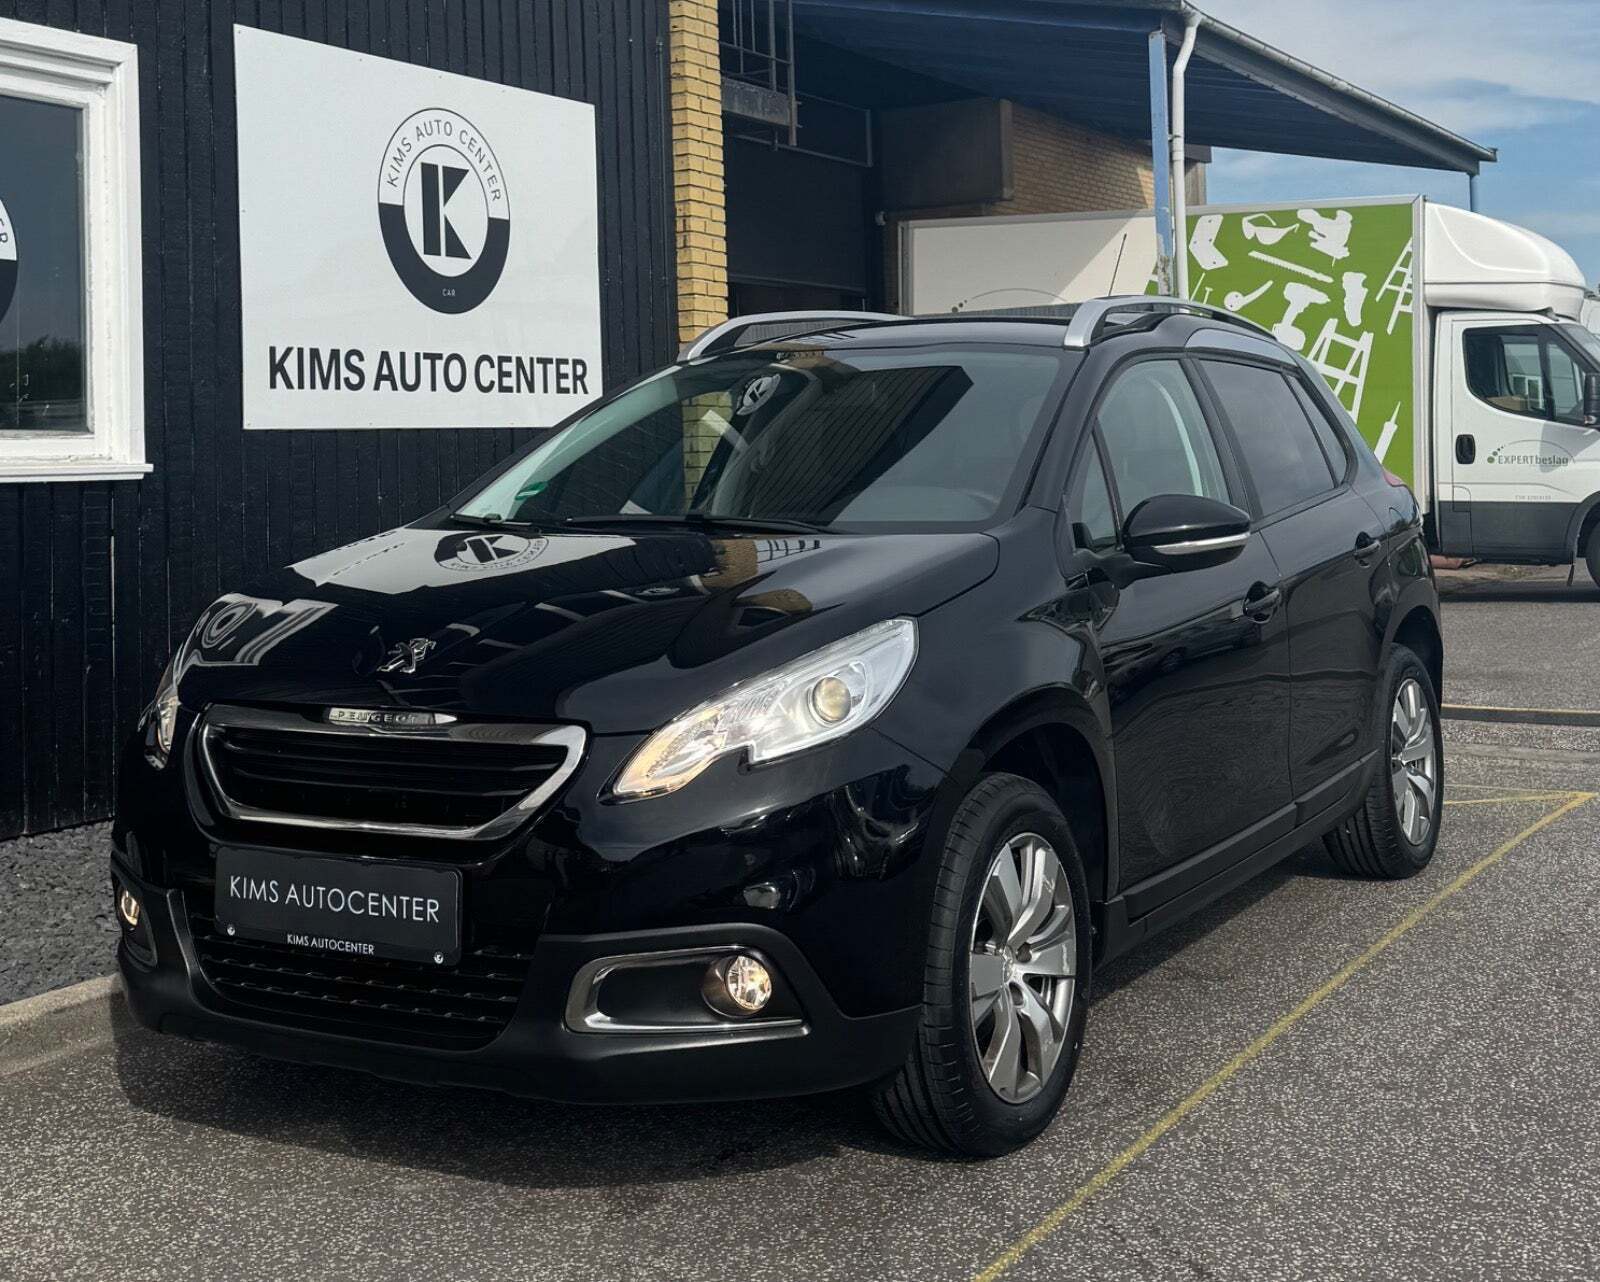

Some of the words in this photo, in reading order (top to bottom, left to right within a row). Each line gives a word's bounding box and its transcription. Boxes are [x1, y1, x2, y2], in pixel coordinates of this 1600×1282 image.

[386, 137, 413, 188] KIMS
[415, 119, 453, 142] AUTO
[458, 129, 502, 202] CENTER
[420, 162, 473, 260] K
[442, 288, 456, 297] CAR
[269, 346, 366, 391] KIMS
[373, 350, 467, 393] AUTO
[474, 354, 589, 395] CENTER
[337, 710, 419, 724] PEUGEOT
[230, 875, 279, 903] KIMS
[285, 883, 440, 923] AUTOCENTER
[287, 933, 310, 947] KIMS
[311, 936, 375, 955] AUTOCENTER
